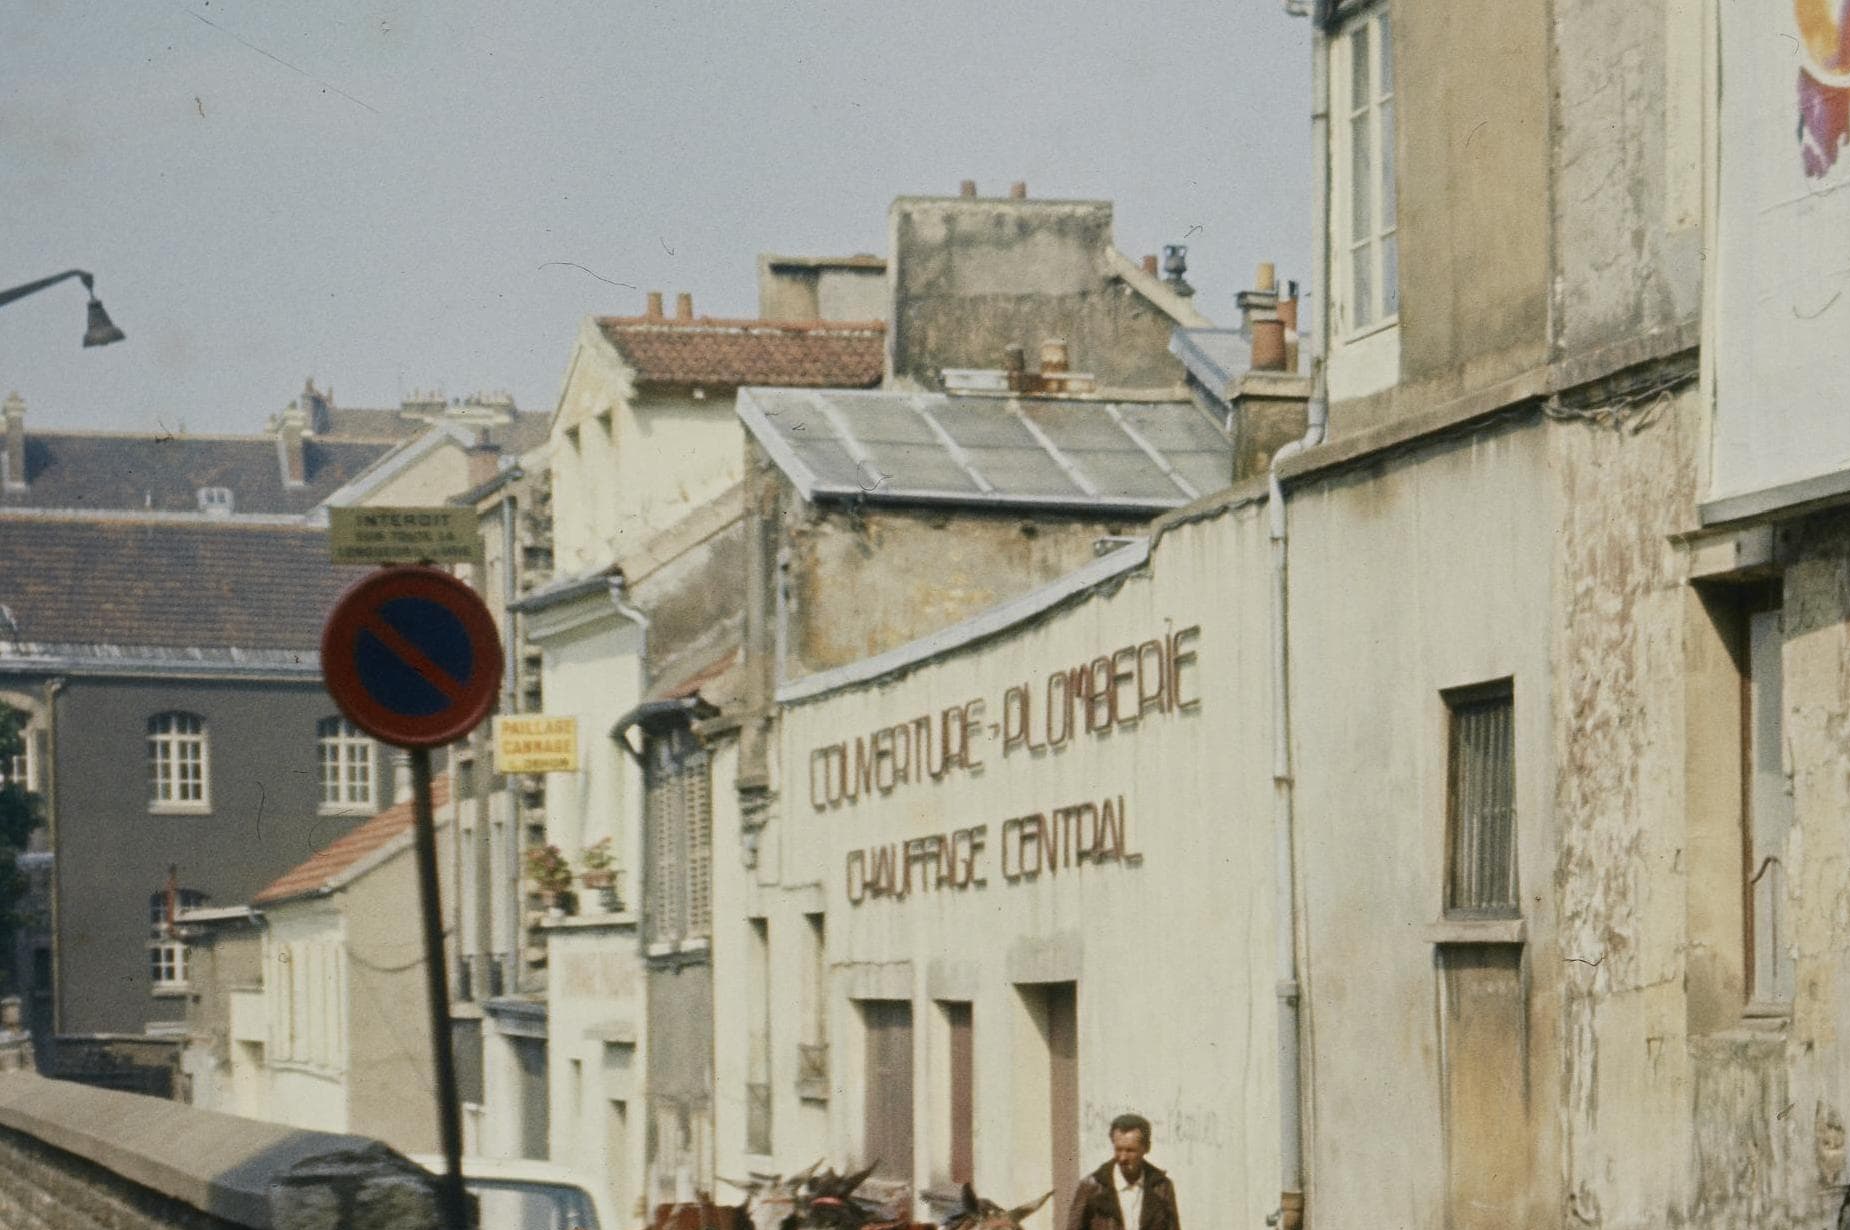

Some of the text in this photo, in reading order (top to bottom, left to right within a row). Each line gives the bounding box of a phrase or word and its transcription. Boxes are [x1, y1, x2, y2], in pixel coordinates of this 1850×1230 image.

[1002, 624, 1202, 759] PLOMBERIE
[846, 794, 1144, 907] CHAUFFAGE CENTRAL
